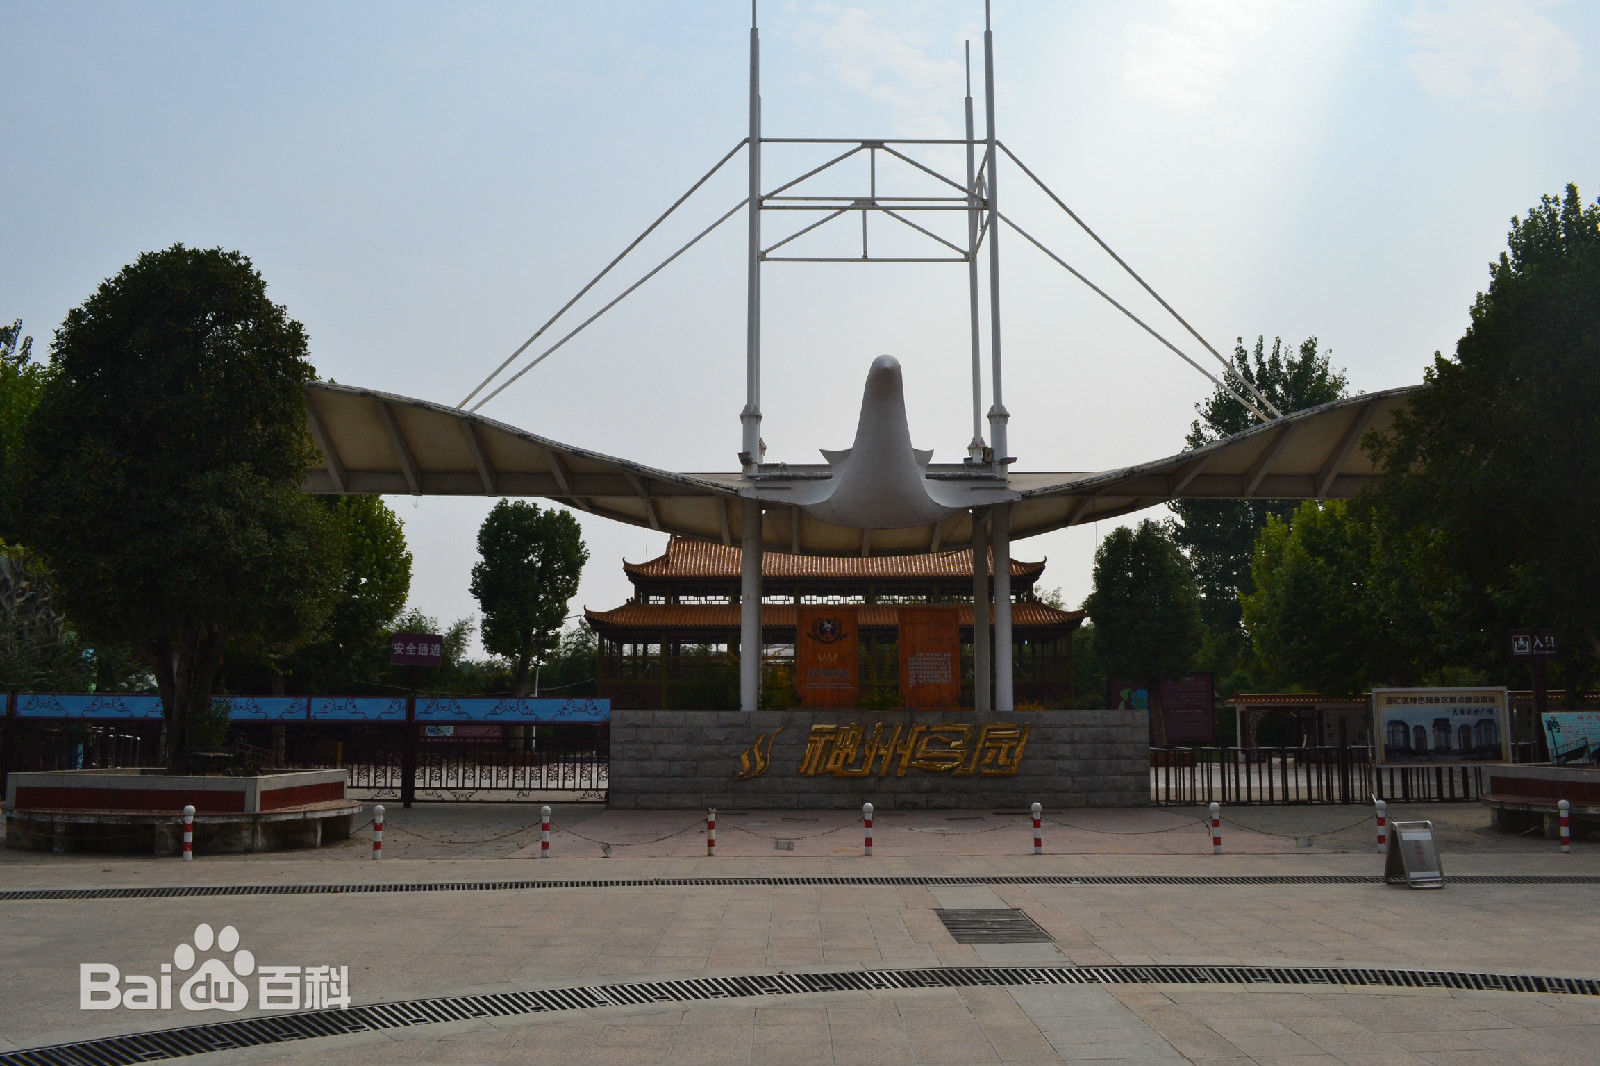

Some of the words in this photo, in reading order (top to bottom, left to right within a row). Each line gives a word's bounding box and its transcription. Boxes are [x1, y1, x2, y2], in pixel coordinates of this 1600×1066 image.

[1532, 635, 1555, 648] 入口
[393, 642, 441, 657] 安全通道
